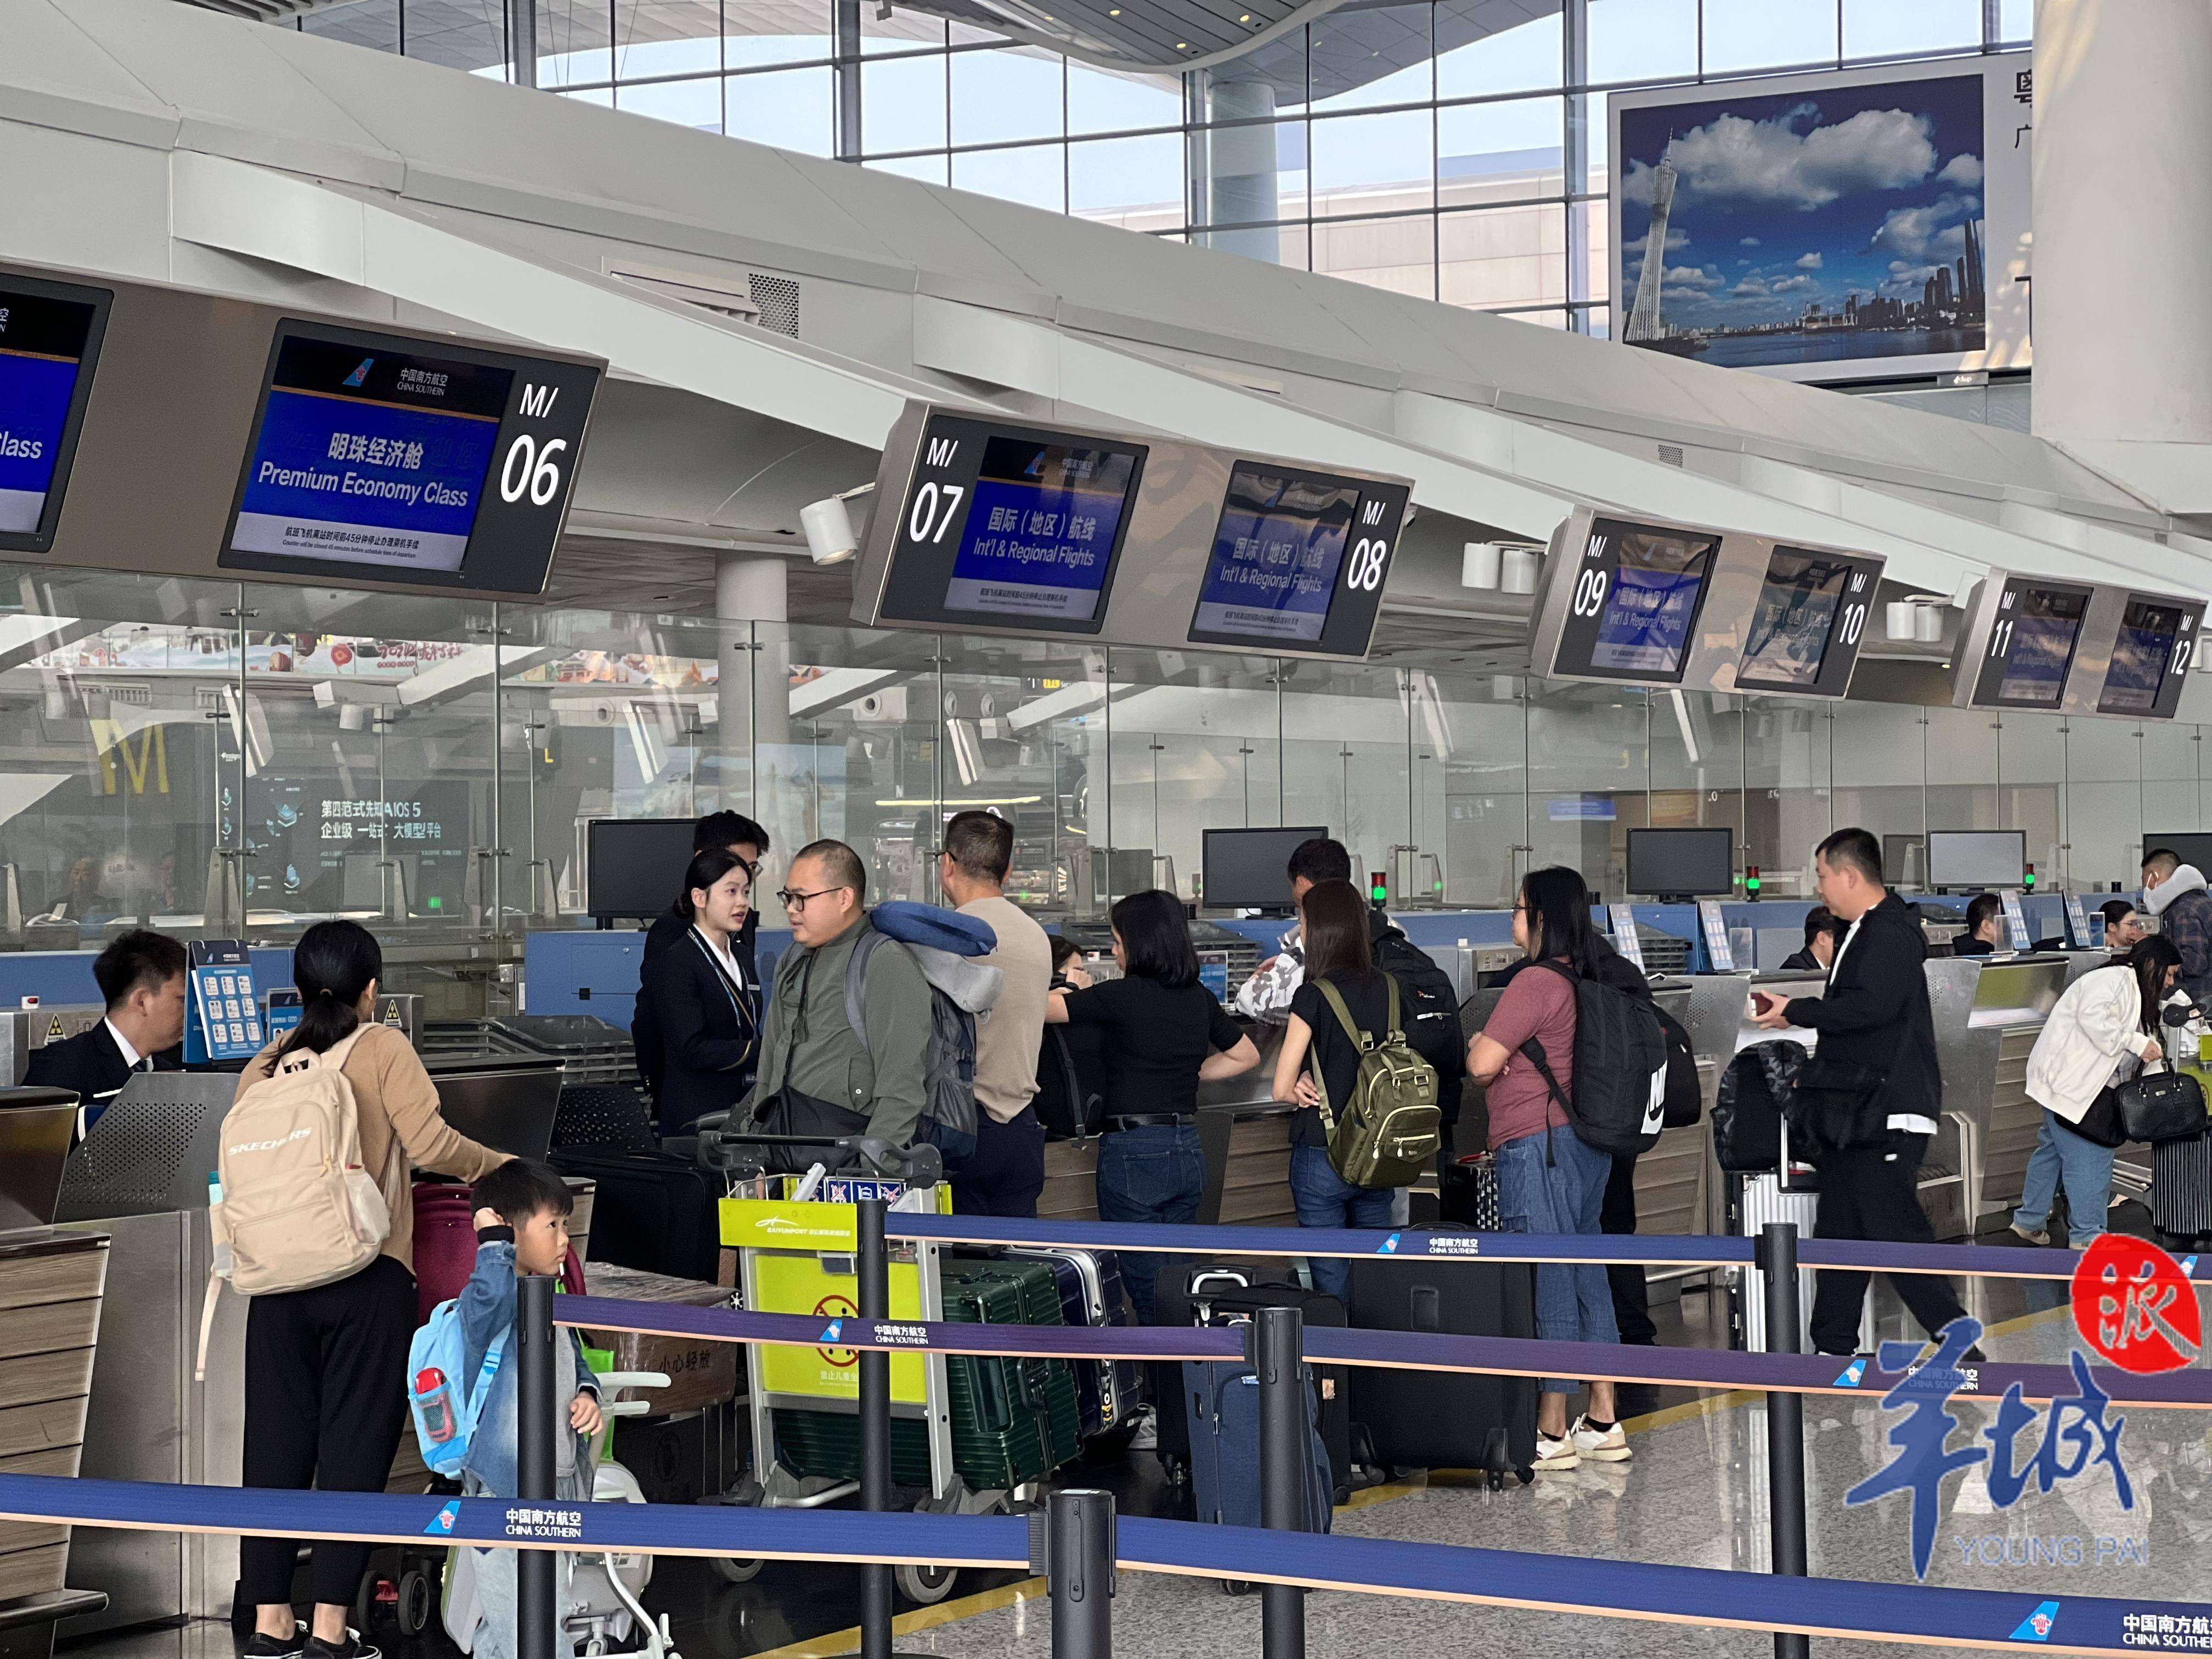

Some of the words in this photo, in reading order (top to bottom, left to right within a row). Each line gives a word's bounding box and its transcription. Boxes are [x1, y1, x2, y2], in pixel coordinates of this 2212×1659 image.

[397, 381, 415, 392] CHINA
[415, 383, 445, 396] SOUTHERN
[400, 367, 449, 387] 中国南方航空
[519, 383, 559, 418] M/
[0, 431, 42, 459] lass
[328, 432, 424, 470] 明珠经济舱
[926, 437, 959, 467] M/
[258, 460, 338, 492] Premium
[341, 471, 422, 506] Economy
[423, 481, 469, 507] Class
[500, 434, 567, 506] 06
[910, 482, 964, 543] 07
[987, 506, 1097, 541] 国际（地区）航线
[1362, 500, 1386, 526] M/
[973, 537, 997, 556] Int'l
[996, 539, 1006, 558] &
[1007, 540, 1059, 565] Regional
[1057, 545, 1096, 569] Flights
[1347, 538, 1387, 591] 08
[1239, 567, 1248, 584] &
[1248, 568, 1293, 590] Regional
[1290, 572, 1323, 594] Flights
[1575, 568, 1607, 617] 09
[1623, 612, 1629, 625] &
[1629, 612, 1660, 630] Regional
[1838, 603, 1865, 645] 10
[1991, 619, 2013, 658] 11
[2171, 640, 2191, 675] 12
[413, 802, 421, 817] 5
[321, 822, 353, 839] 企业级
[393, 822, 441, 839] 大模型平台
[228, 1126, 312, 1156] SKECHRS
[1429, 1237, 1479, 1248] 中国南方航空
[874, 1324, 927, 1337] 中国南方航空
[895, 1336, 929, 1345] SOUTHERN
[505, 1525, 533, 1536] CHINA
[534, 1526, 582, 1538] SOUTHERN
[506, 1508, 582, 1527] 中国南方航空
[2123, 1613, 2212, 1635] 中国南方航
[2123, 1632, 2160, 1645] CHINA
[2163, 1634, 2212, 1649] SOUTHE
